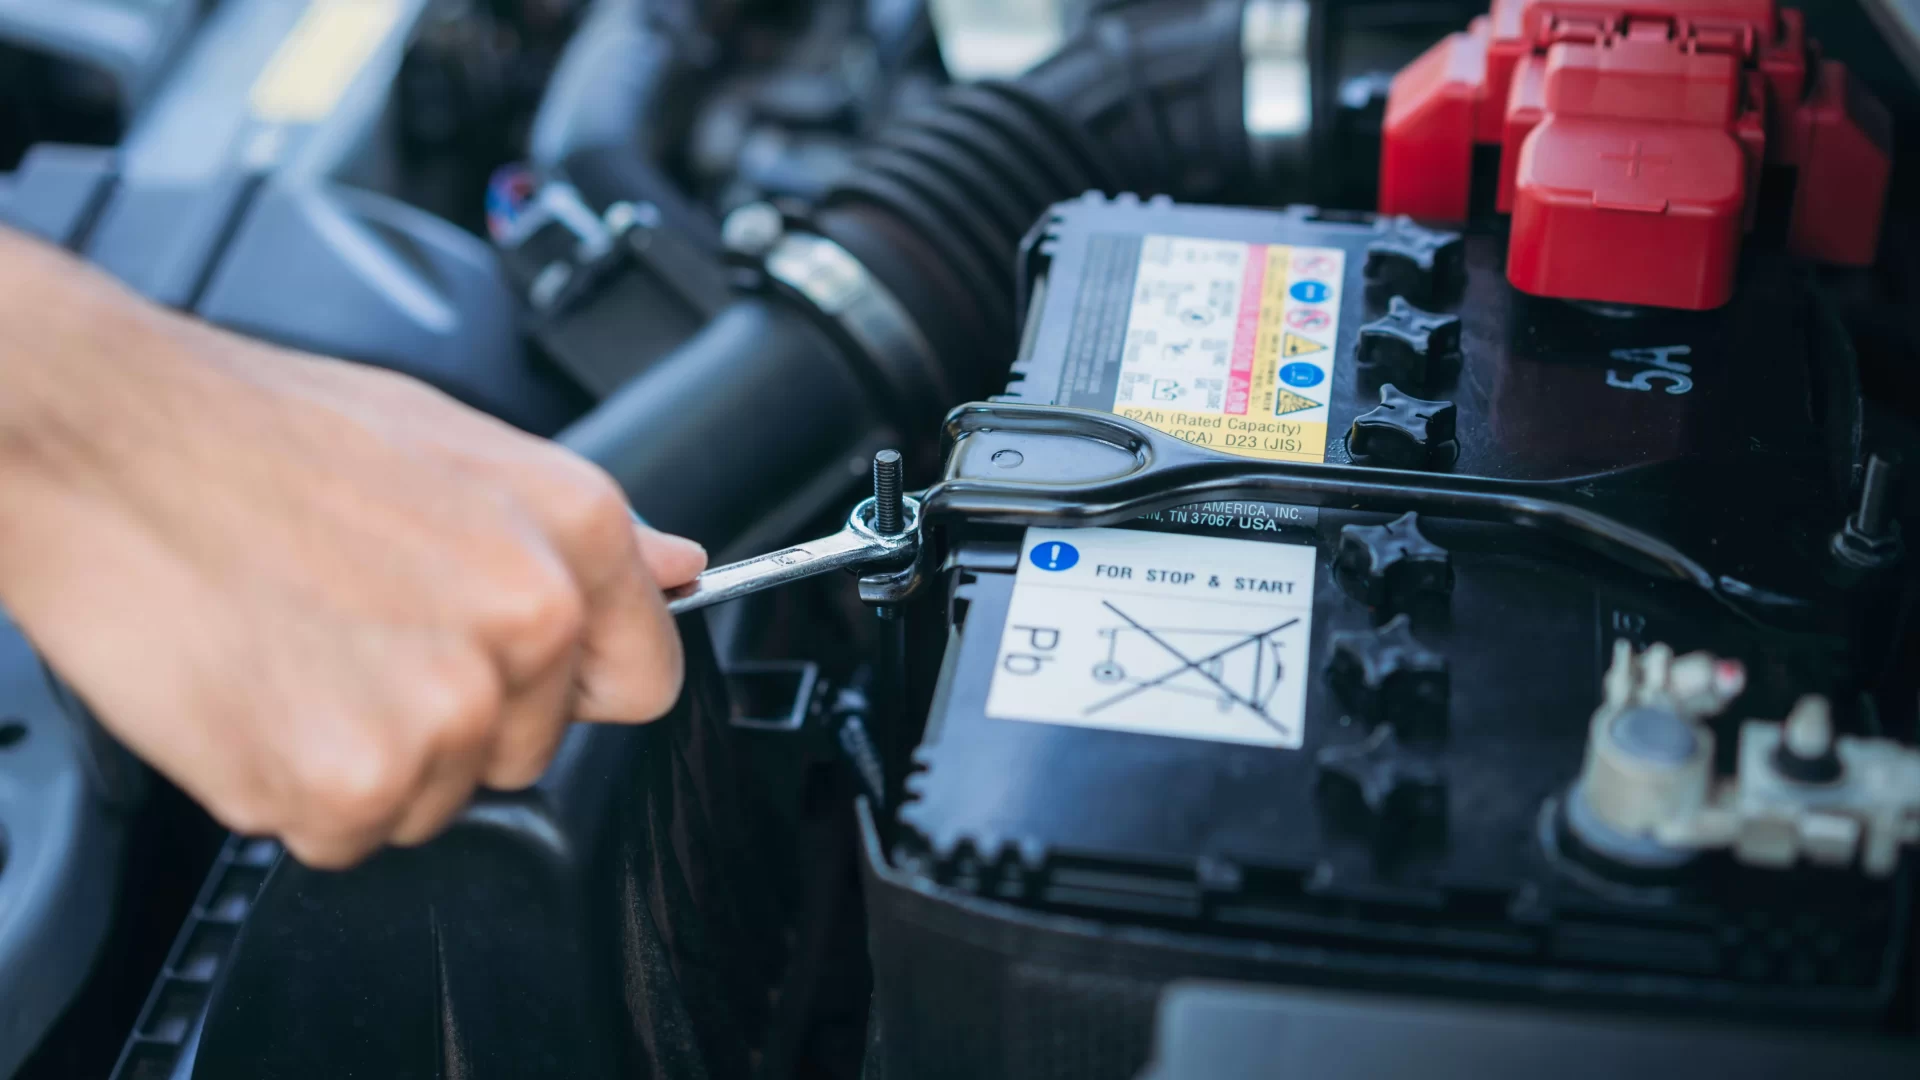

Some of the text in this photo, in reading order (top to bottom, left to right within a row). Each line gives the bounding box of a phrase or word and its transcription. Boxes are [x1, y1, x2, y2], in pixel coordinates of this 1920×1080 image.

[1606, 345, 1693, 394] 5A
[1123, 408, 1302, 437] 62Ah (Rated Capacity)
[1225, 433, 1257, 448] D23
[1263, 437, 1302, 452] (JIS)
[1169, 510, 1188, 523] TN
[1190, 512, 1234, 527] 37067
[1238, 517, 1282, 532] USA.
[1202, 502, 1270, 518] AMERICA,
[1275, 506, 1303, 520] INC.
[1095, 564, 1296, 595] FOR STOP & START
[1003, 624, 1059, 676] Pb
